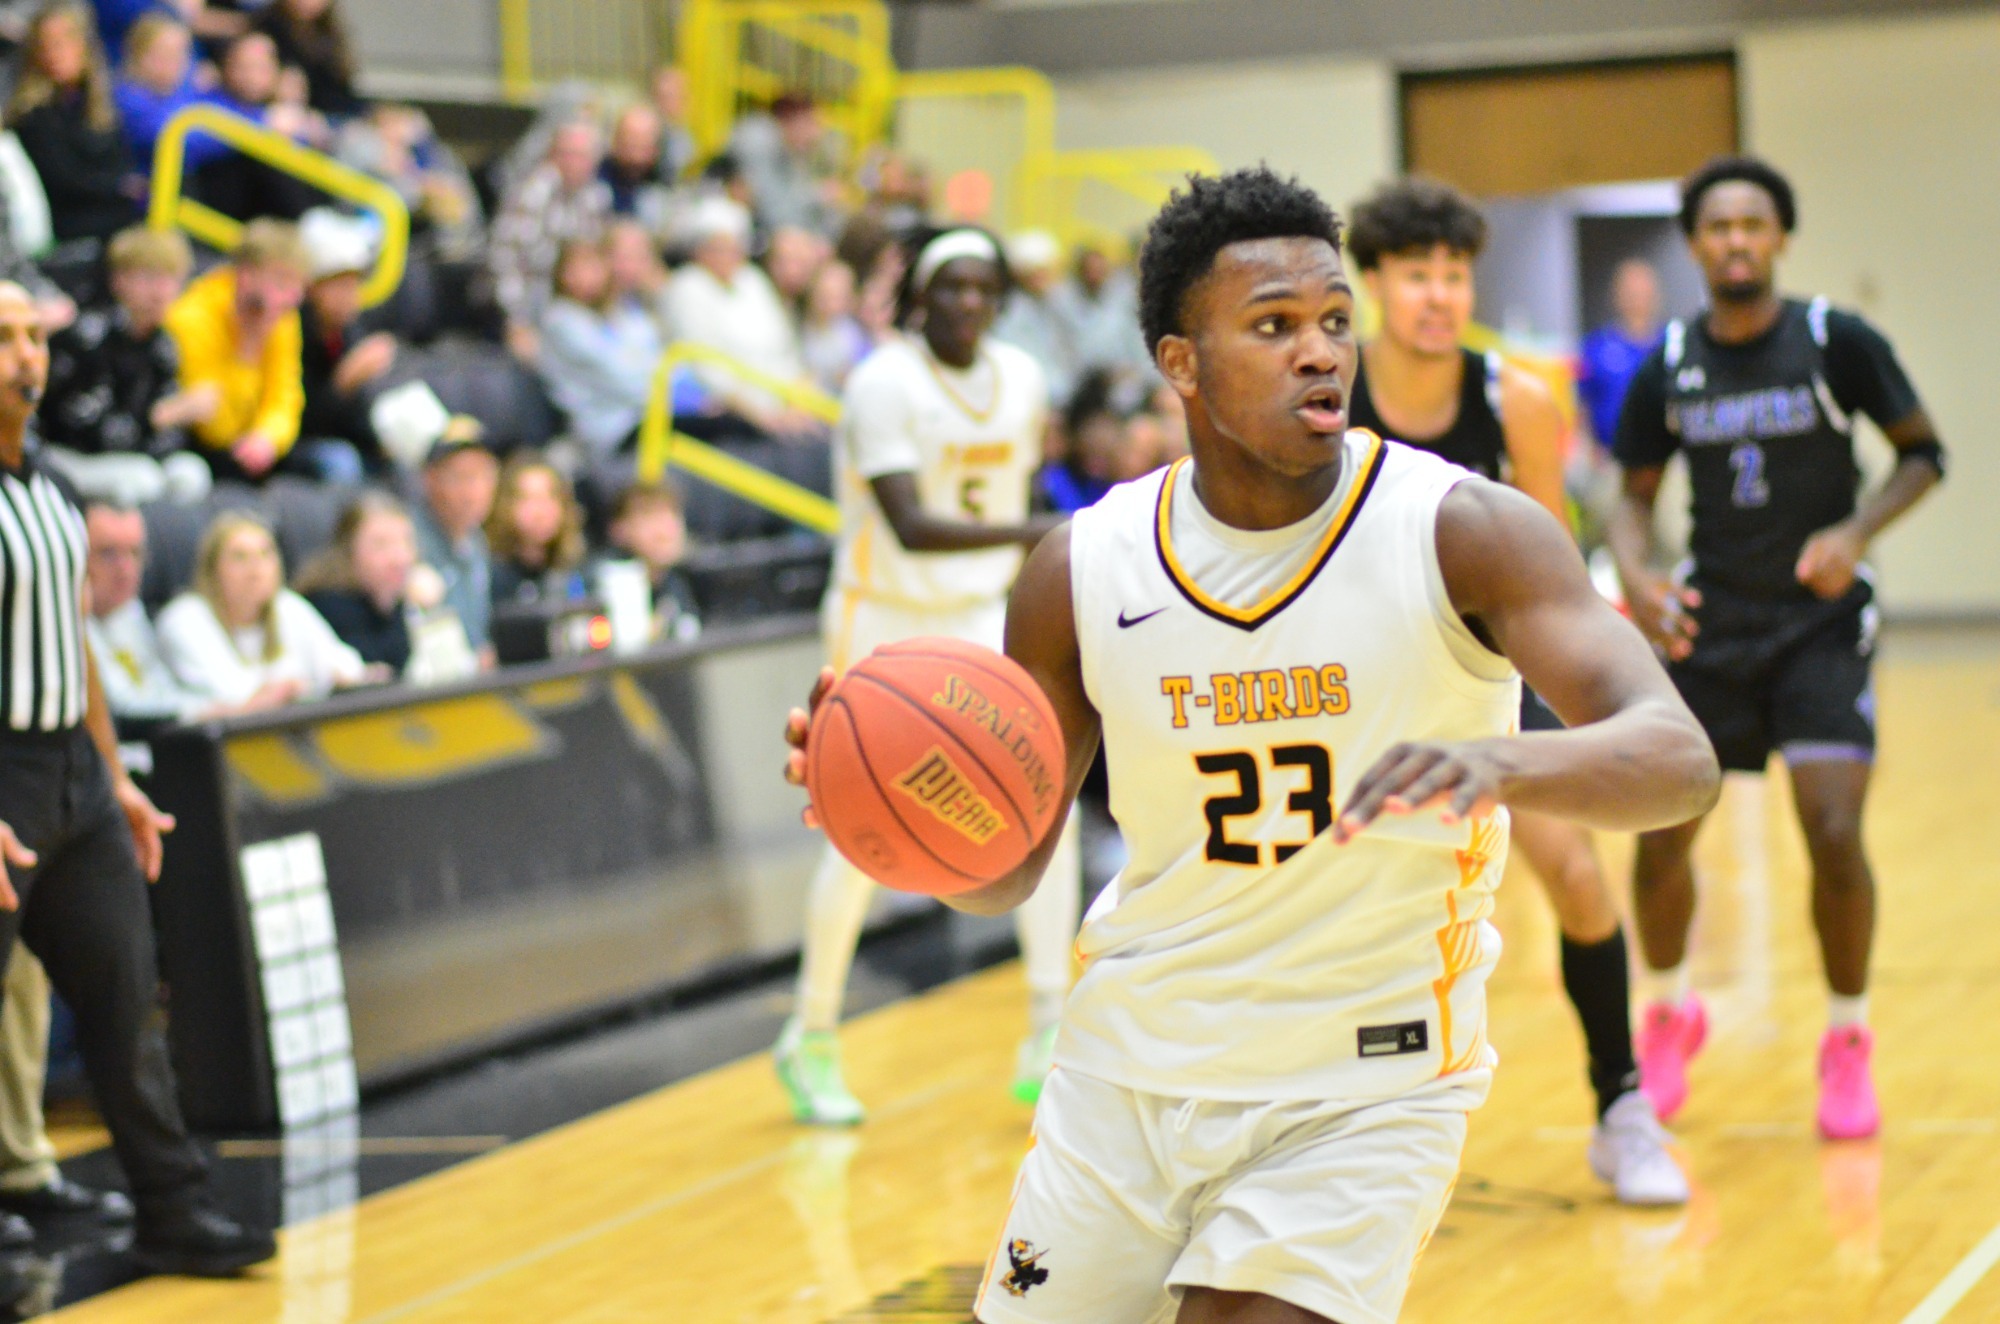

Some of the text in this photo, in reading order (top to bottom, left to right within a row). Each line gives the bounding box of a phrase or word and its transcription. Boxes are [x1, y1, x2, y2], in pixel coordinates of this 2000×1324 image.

[1729, 442, 1769, 507] 2
[1160, 663, 1351, 728] T-BIRDS
[1191, 741, 1333, 867] 23
[1405, 1030, 1420, 1046] XL
